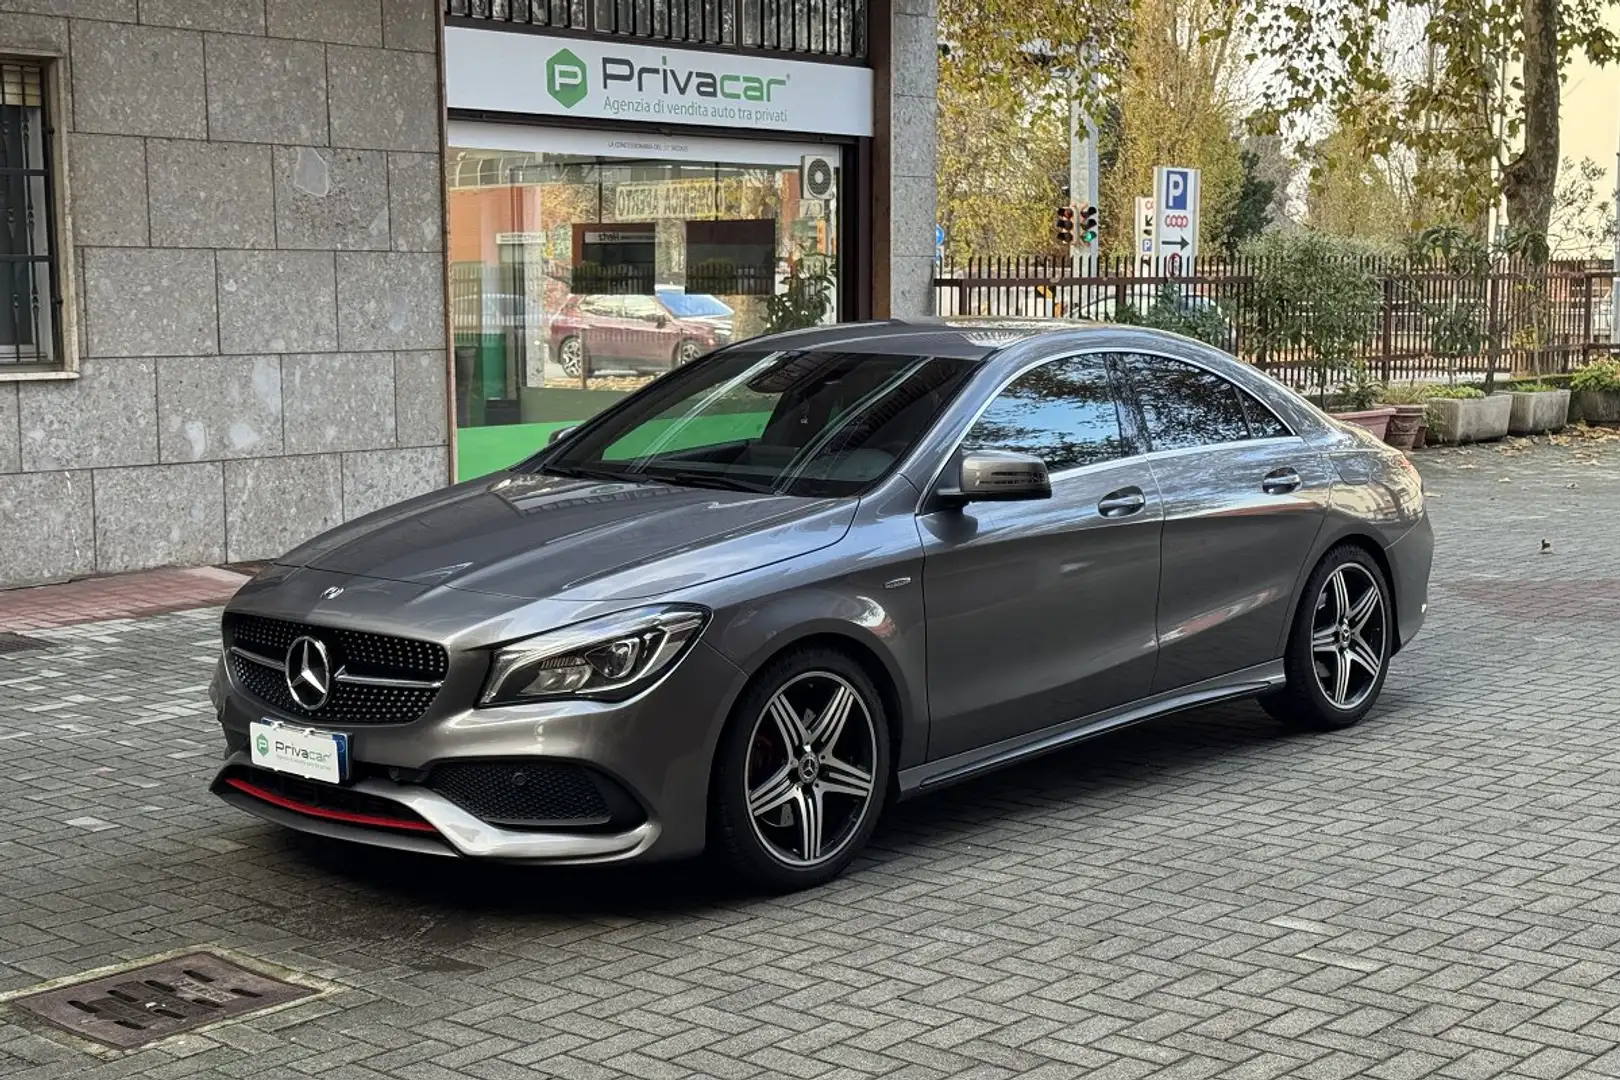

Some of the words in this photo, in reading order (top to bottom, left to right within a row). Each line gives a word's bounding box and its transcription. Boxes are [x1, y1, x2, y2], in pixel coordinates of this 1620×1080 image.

[602, 55, 787, 102] Privacar
[603, 96, 649, 115] Agenzia
[653, 99, 664, 114] di
[667, 101, 708, 117] vendita
[711, 107, 736, 119] auto
[738, 108, 752, 120] tra
[755, 109, 787, 124] privati
[1168, 173, 1184, 207] P
[275, 740, 332, 763] Privacar
